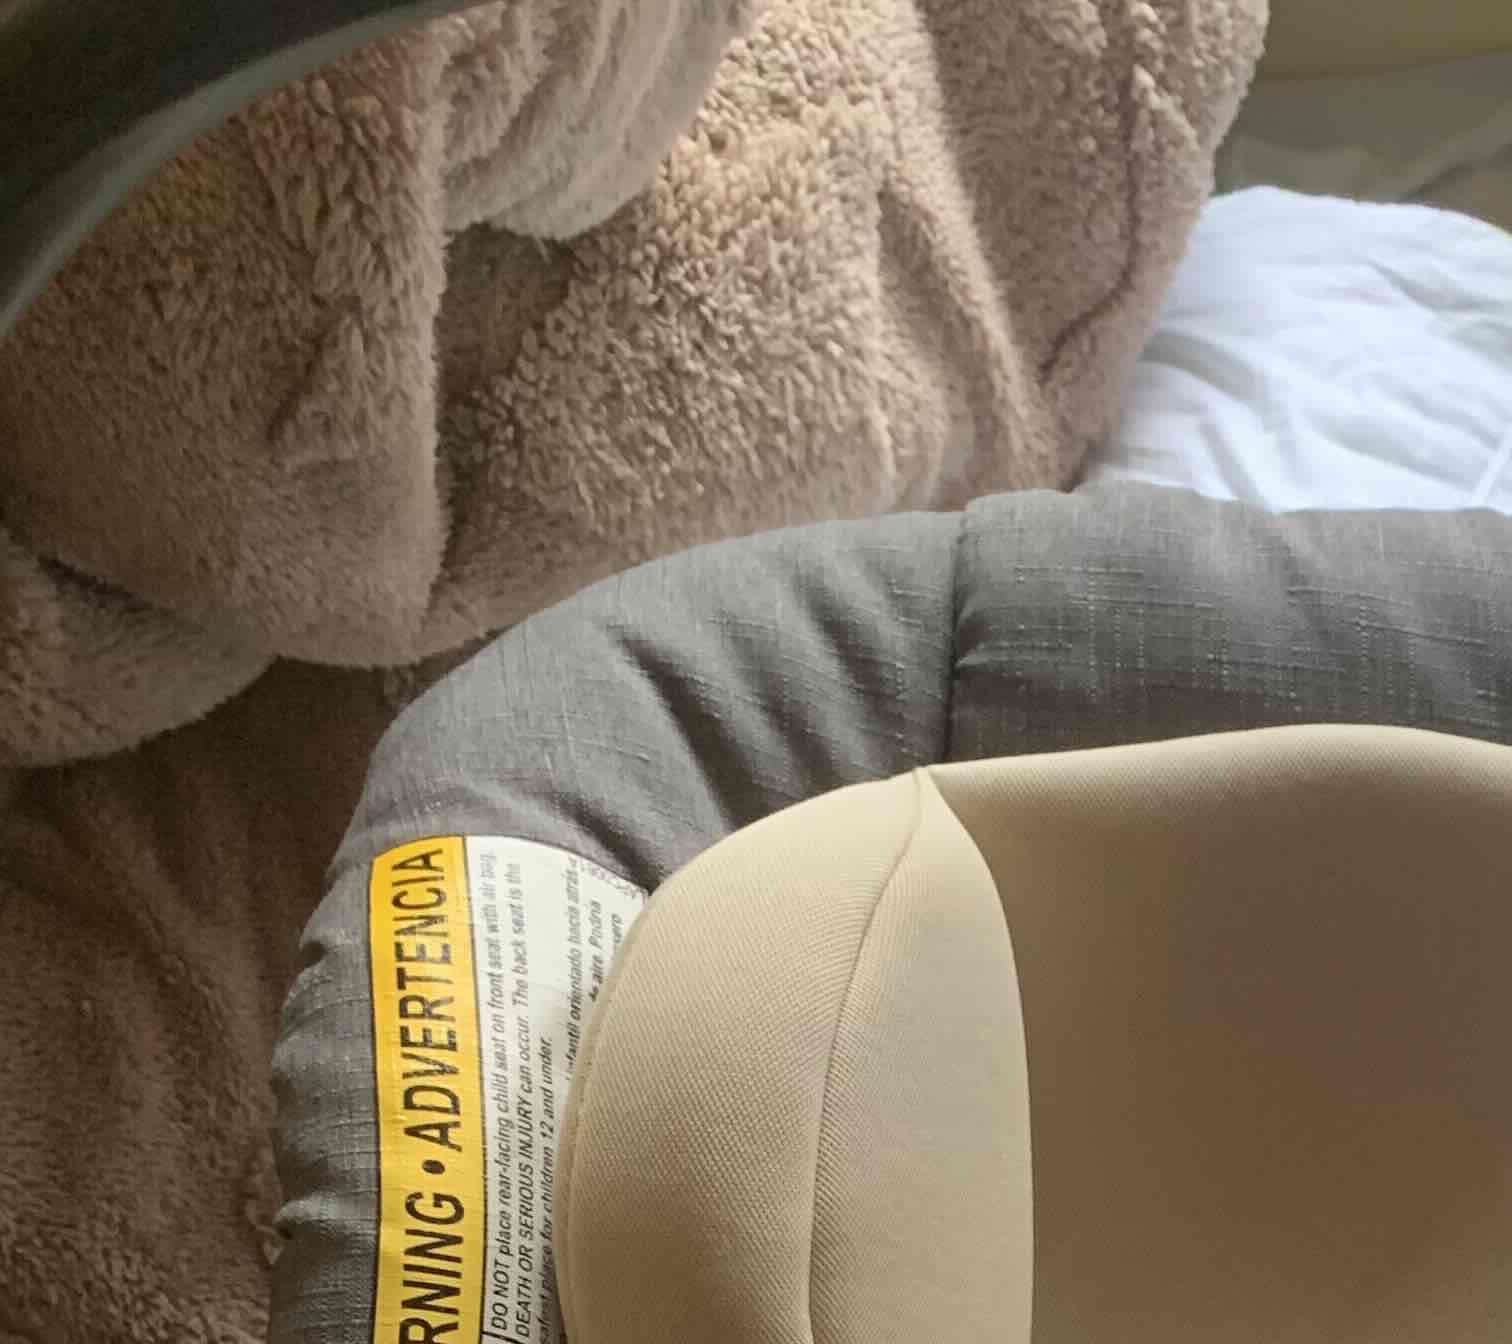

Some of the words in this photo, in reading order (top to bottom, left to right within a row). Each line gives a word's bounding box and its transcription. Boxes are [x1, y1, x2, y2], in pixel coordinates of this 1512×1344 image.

[504, 861, 520, 883] the
[505, 887, 521, 899] is
[482, 903, 498, 932] with
[509, 902, 525, 934] seat
[566, 905, 582, 944] hacia
[485, 937, 502, 968] seat
[510, 939, 527, 975] back
[392, 848, 462, 1151] ADVERTENCIA
[487, 971, 504, 1009] front
[512, 978, 528, 1006] The
[567, 948, 583, 1020] orientado
[491, 1013, 505, 1028] on
[492, 1036, 508, 1069] seat
[491, 1072, 509, 1112] child
[518, 1065, 532, 1092] can
[539, 1085, 554, 1118] and
[516, 1094, 533, 1159] INJURY
[539, 1120, 554, 1139] 12
[494, 1116, 514, 1206] rear-facing
[539, 1145, 554, 1213] children
[518, 1162, 534, 1240] SERIOUS
[496, 1209, 513, 1255] place
[538, 1215, 553, 1241] for
[518, 1244, 534, 1271] OR
[493, 1258, 510, 1297] NOT
[491, 1302, 508, 1329] DO
[515, 1275, 532, 1337] DEATH
